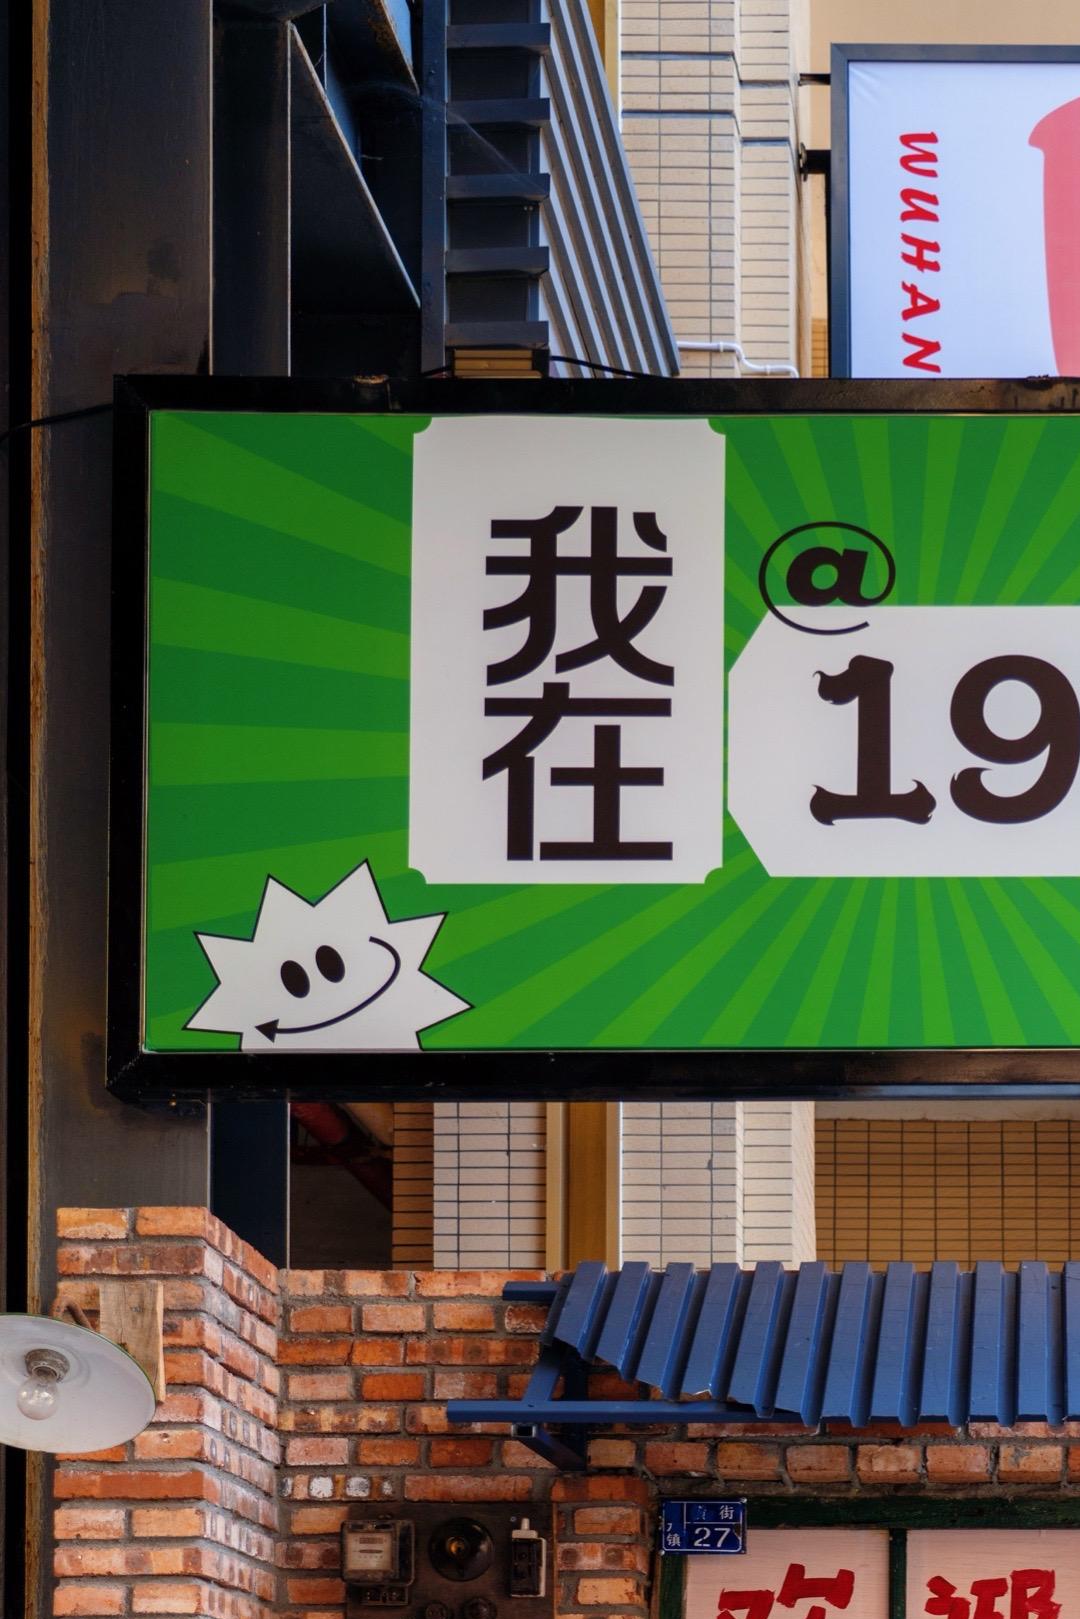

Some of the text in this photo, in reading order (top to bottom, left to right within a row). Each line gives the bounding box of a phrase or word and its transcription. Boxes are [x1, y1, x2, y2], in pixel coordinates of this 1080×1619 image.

[899, 131, 942, 374] WUHAN
[482, 505, 675, 861] 我在
[693, 1526, 732, 1548] 27
